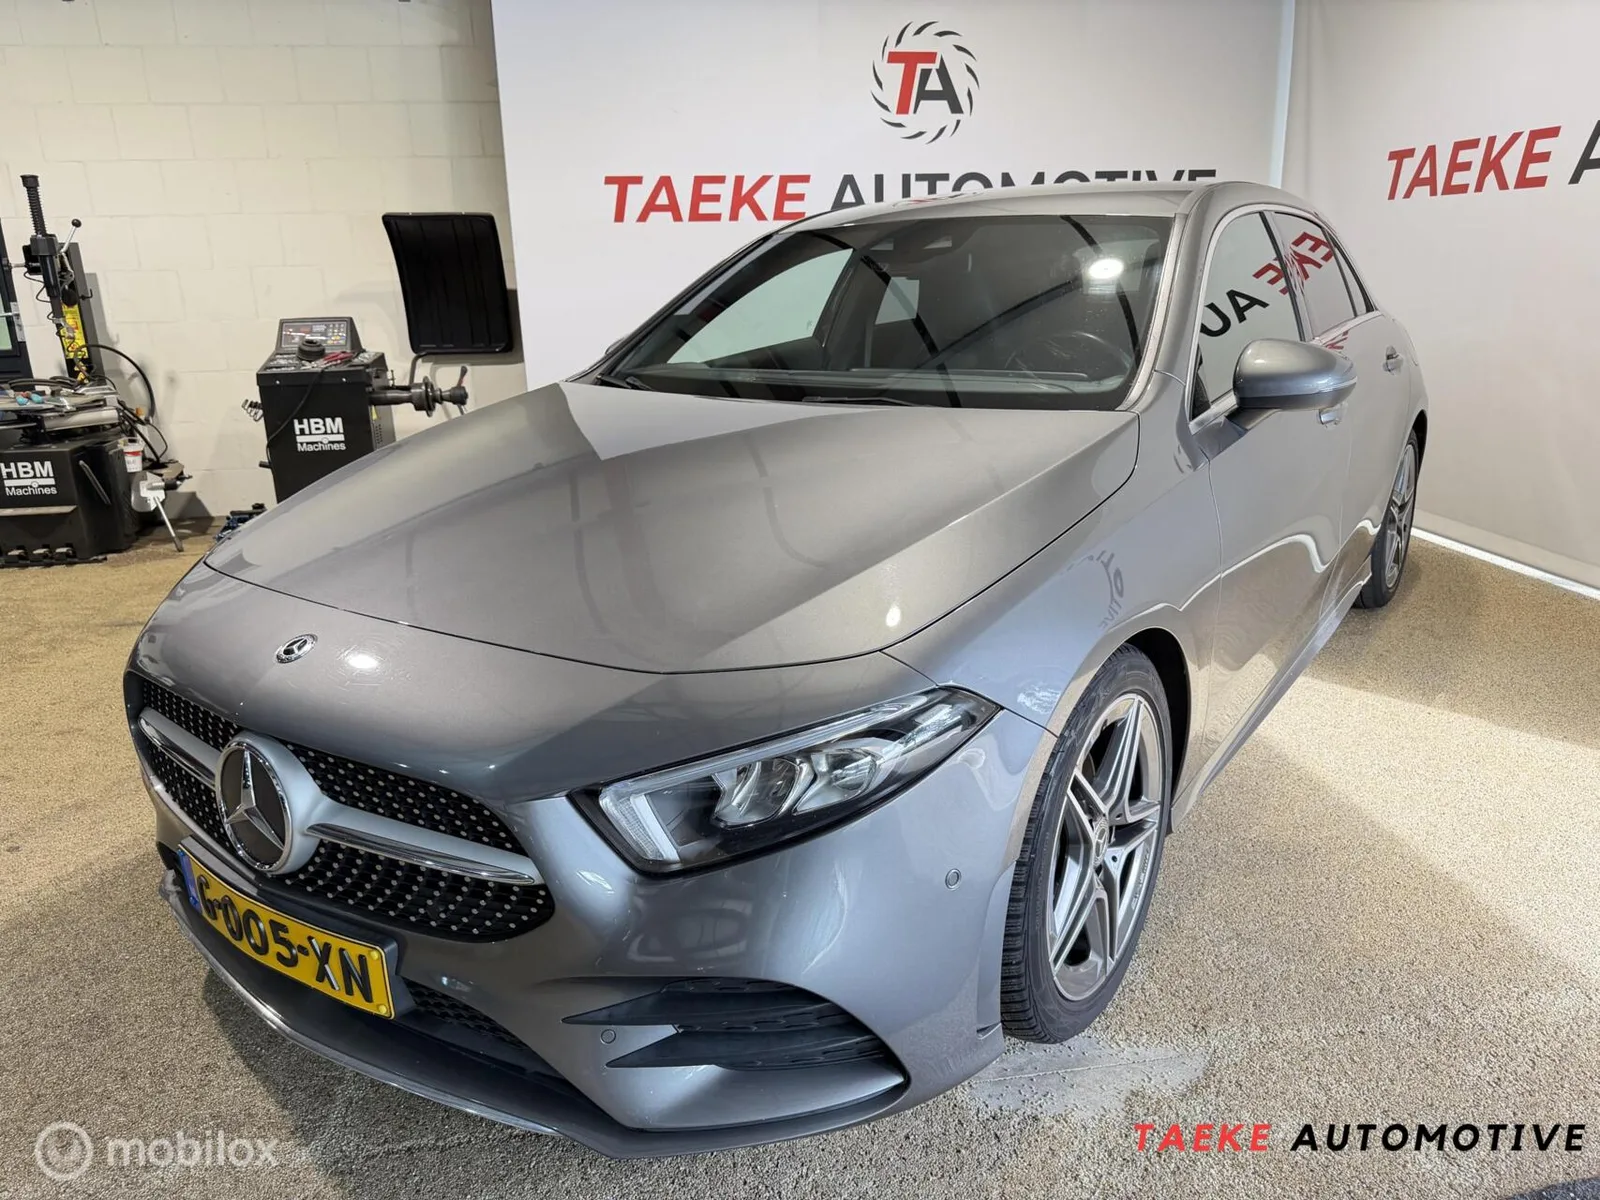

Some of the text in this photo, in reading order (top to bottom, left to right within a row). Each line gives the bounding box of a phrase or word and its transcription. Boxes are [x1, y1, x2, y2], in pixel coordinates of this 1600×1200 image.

[886, 51, 965, 115] TA
[1387, 125, 1562, 201] TAEKE
[604, 174, 811, 223] TAEKE
[293, 417, 344, 435] HBM
[297, 441, 346, 452] Machines
[0, 461, 54, 479] HBM
[5, 485, 58, 496] Machines
